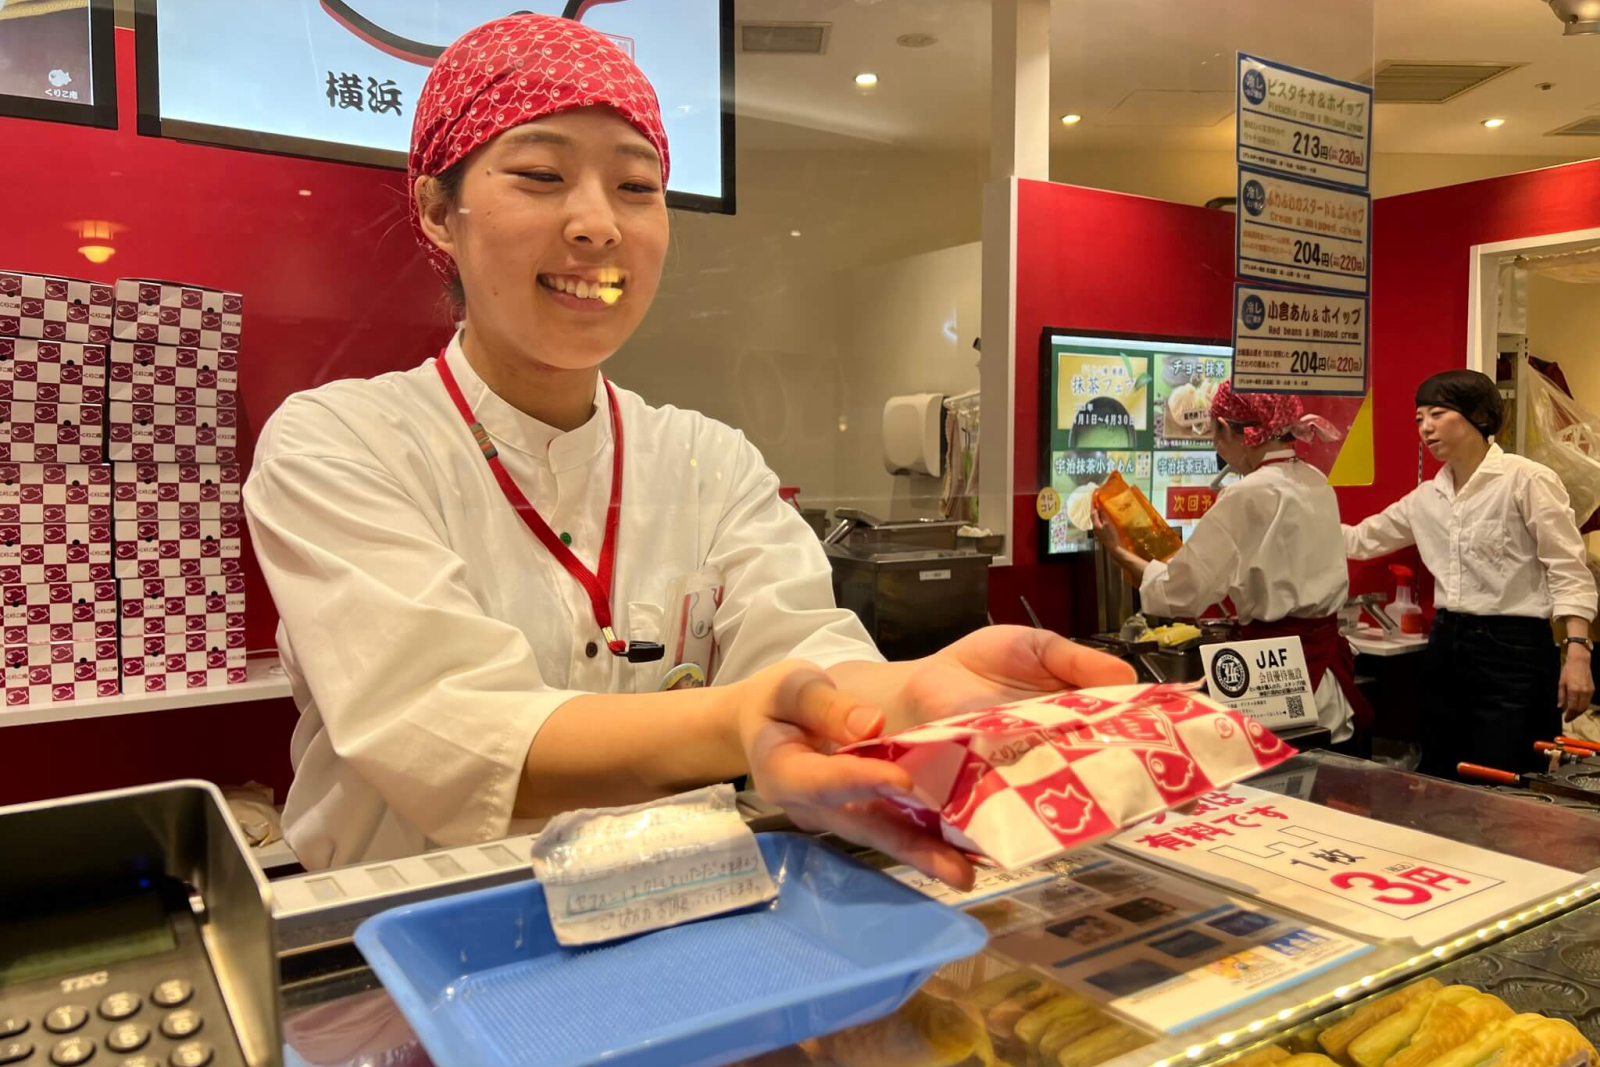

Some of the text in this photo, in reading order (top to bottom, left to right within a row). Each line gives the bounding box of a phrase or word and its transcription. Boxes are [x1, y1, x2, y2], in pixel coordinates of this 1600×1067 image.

[326, 70, 402, 116] 横浜
[1256, 648, 1287, 669] JAF
[1134, 805, 1289, 851] 有料です
[1290, 849, 1366, 872] 1枚
[1330, 866, 1472, 905] 3円
